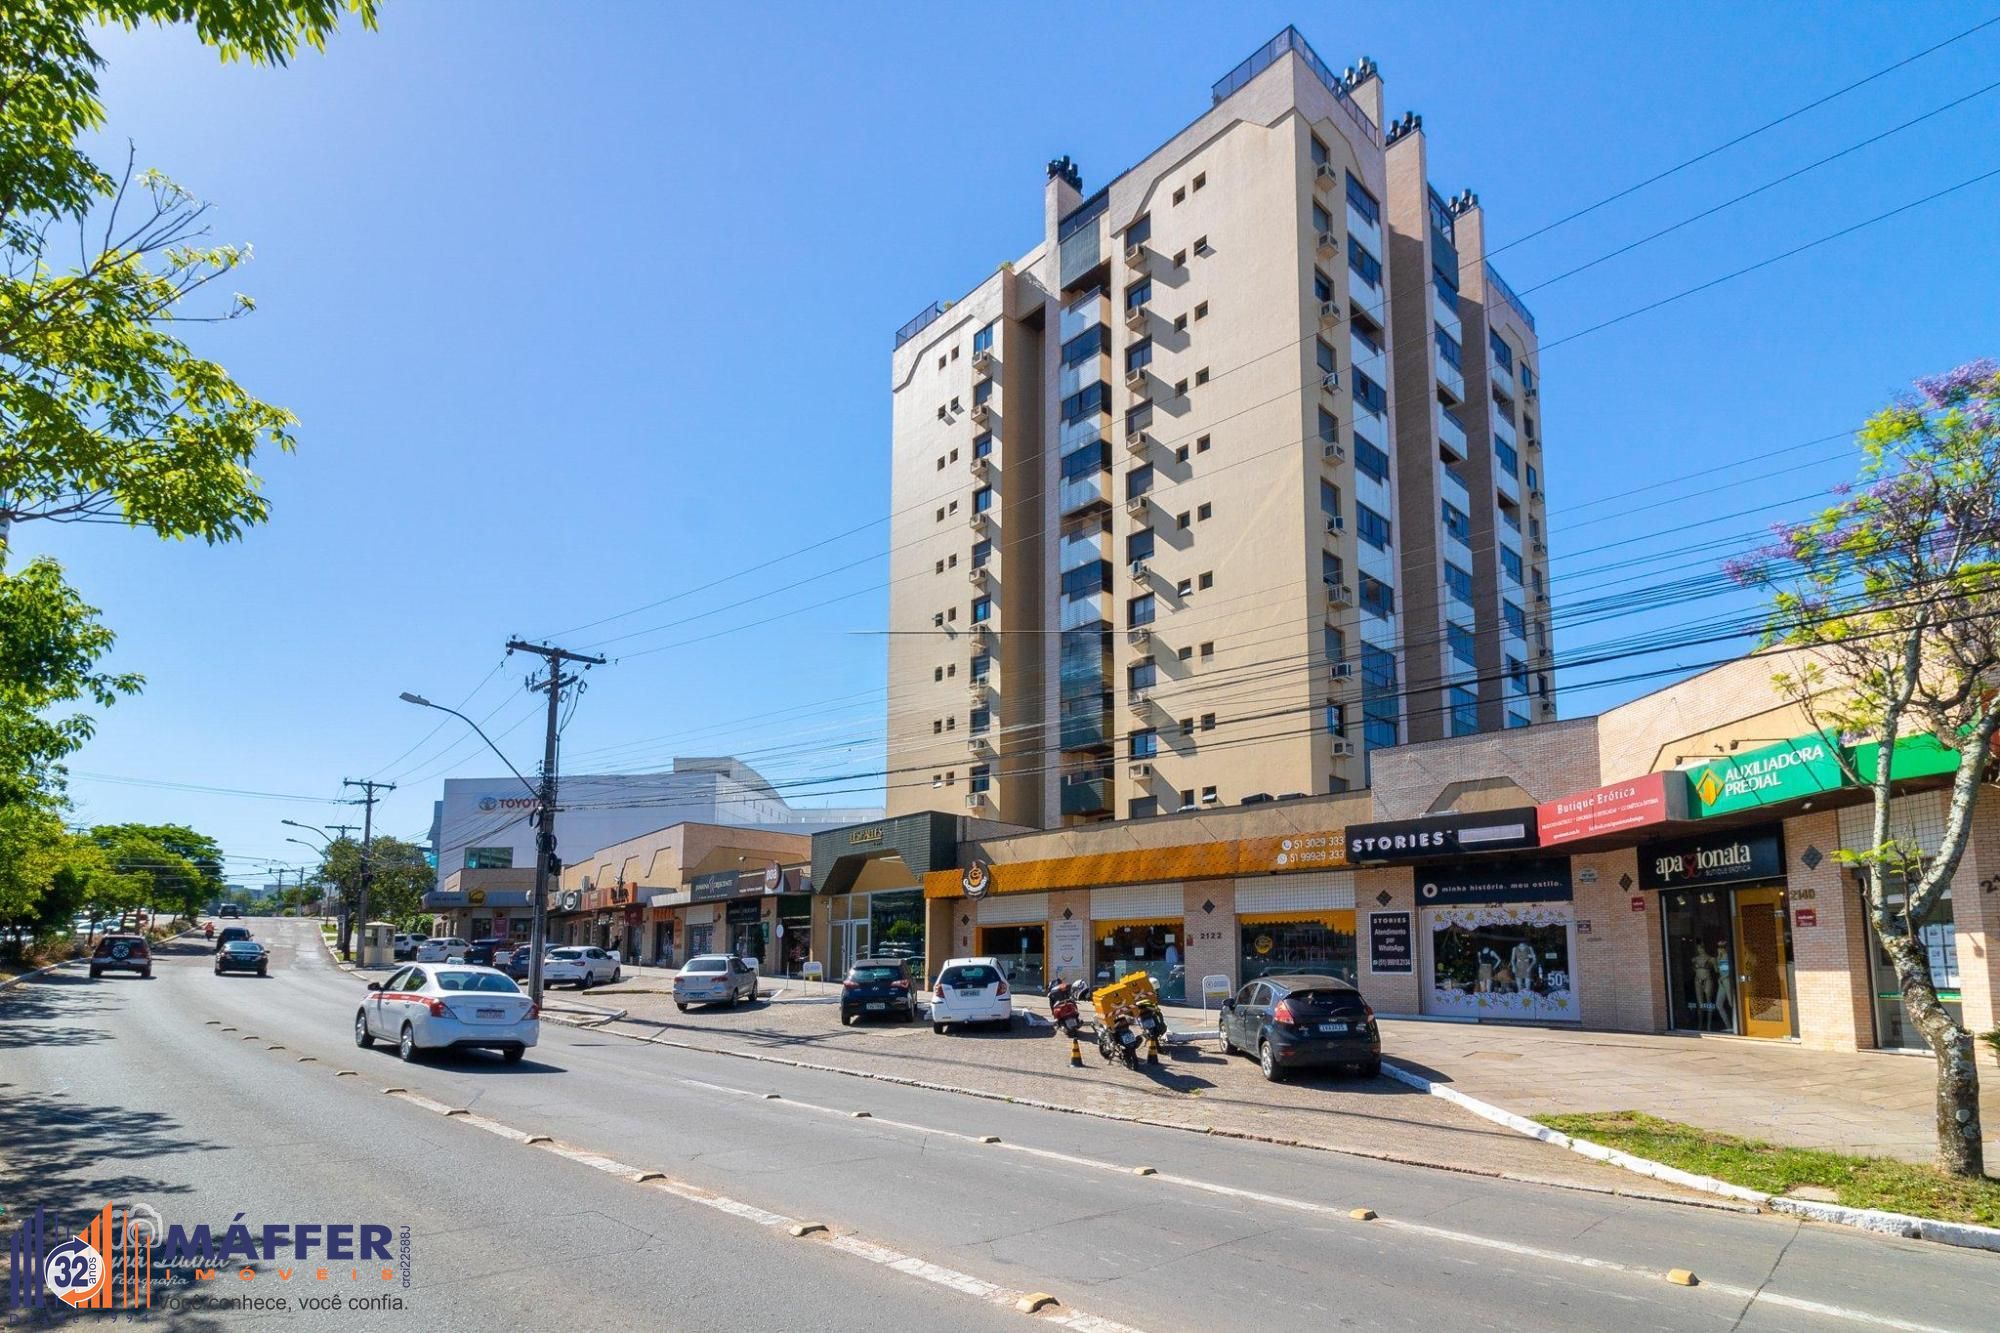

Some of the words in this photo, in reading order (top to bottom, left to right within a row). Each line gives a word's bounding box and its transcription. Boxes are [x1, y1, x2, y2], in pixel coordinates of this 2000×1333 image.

[1725, 744, 1824, 782] AUXILIADORA
[1725, 772, 1782, 797] PREDIAL
[1557, 798, 1595, 815] Butique
[1597, 787, 1636, 804] Erótica
[1294, 840, 1303, 850] 51
[1352, 831, 1444, 852] STORIES
[1290, 853, 1298, 863] 51
[1791, 888, 1815, 900] 2140
[1200, 932, 1222, 940] 2122
[1374, 928, 1407, 936] Atendimento
